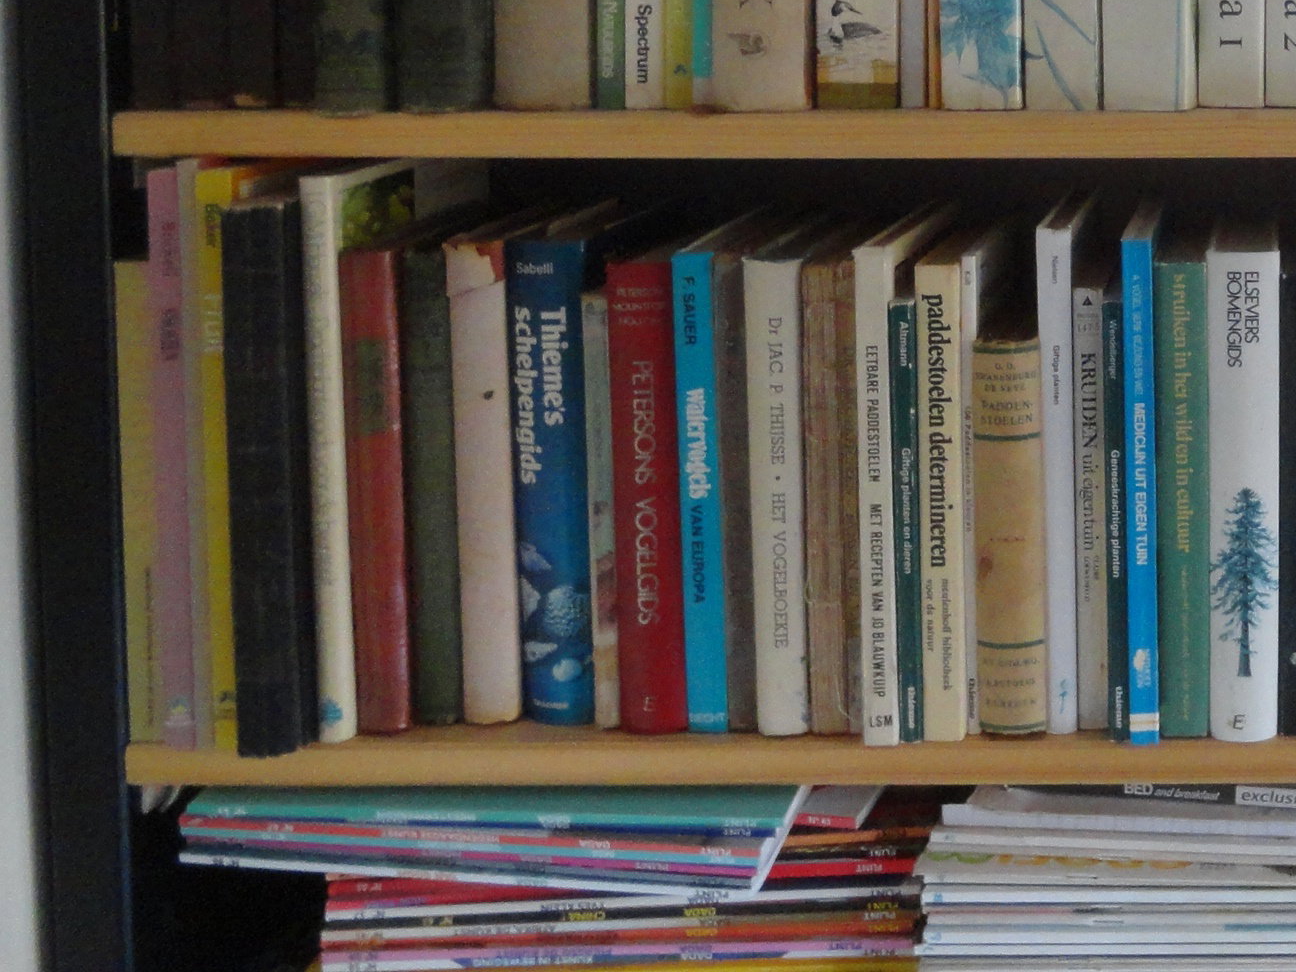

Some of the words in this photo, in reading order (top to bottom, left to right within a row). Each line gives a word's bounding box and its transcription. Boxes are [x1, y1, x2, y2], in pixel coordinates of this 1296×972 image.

[633, 4, 652, 84] Spectrum
[1226, 271, 1242, 368] BOMENGIDS
[1244, 271, 1260, 344] ELSEVIERS
[513, 306, 542, 485] schelpengids
[540, 307, 569, 426] Thieme's
[922, 294, 951, 427] paddestoelen
[632, 361, 657, 485] PETERSONS
[1134, 403, 1146, 465] MEDICIJN
[930, 431, 953, 568] determineren
[1135, 468, 1146, 488] UIT
[1135, 491, 1147, 531] EIGEN
[634, 498, 659, 625] VOGELGIDS
[1136, 534, 1147, 565] TUIN
